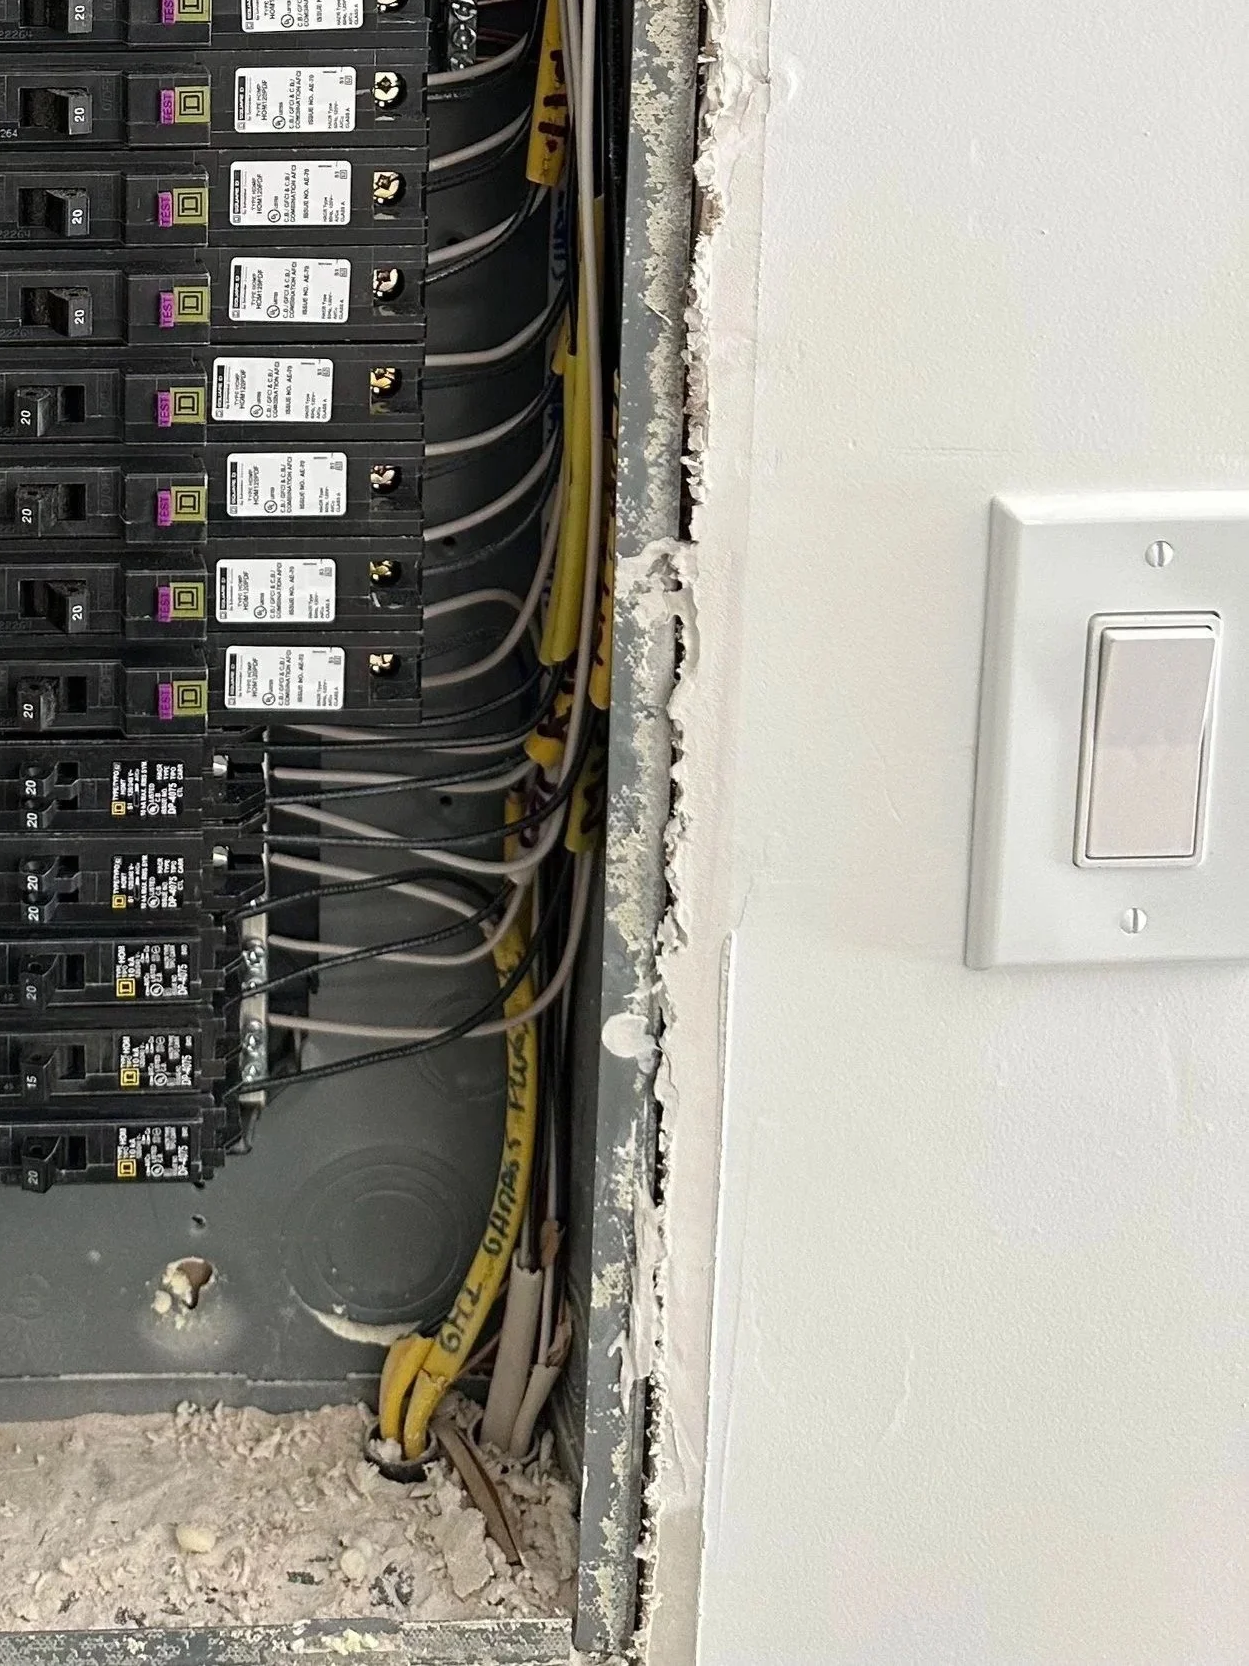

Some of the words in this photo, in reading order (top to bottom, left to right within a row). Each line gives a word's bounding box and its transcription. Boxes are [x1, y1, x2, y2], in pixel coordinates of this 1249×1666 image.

[74, 4, 85, 21] 20
[74, 107, 85, 123] 20
[162, 93, 173, 124] TEST
[72, 209, 83, 225] 20
[161, 194, 172, 225] TEST
[74, 309, 85, 325] 20
[162, 296, 173, 326] TEST
[20, 410, 31, 425] 20
[160, 395, 171, 425] TEST
[21, 508, 32, 524] 20
[160, 495, 171, 525] TEST
[72, 605, 83, 620] 20
[160, 590, 170, 621] TEST
[161, 686, 172, 719] TEST
[23, 703, 34, 719] 20
[25, 780, 37, 795] 20
[27, 813, 38, 828] 20
[27, 875, 38, 891] 20
[28, 906, 39, 921] 20
[26, 986, 37, 1000] 20
[27, 1075, 37, 1088] 15
[28, 1171, 39, 1184] 20
